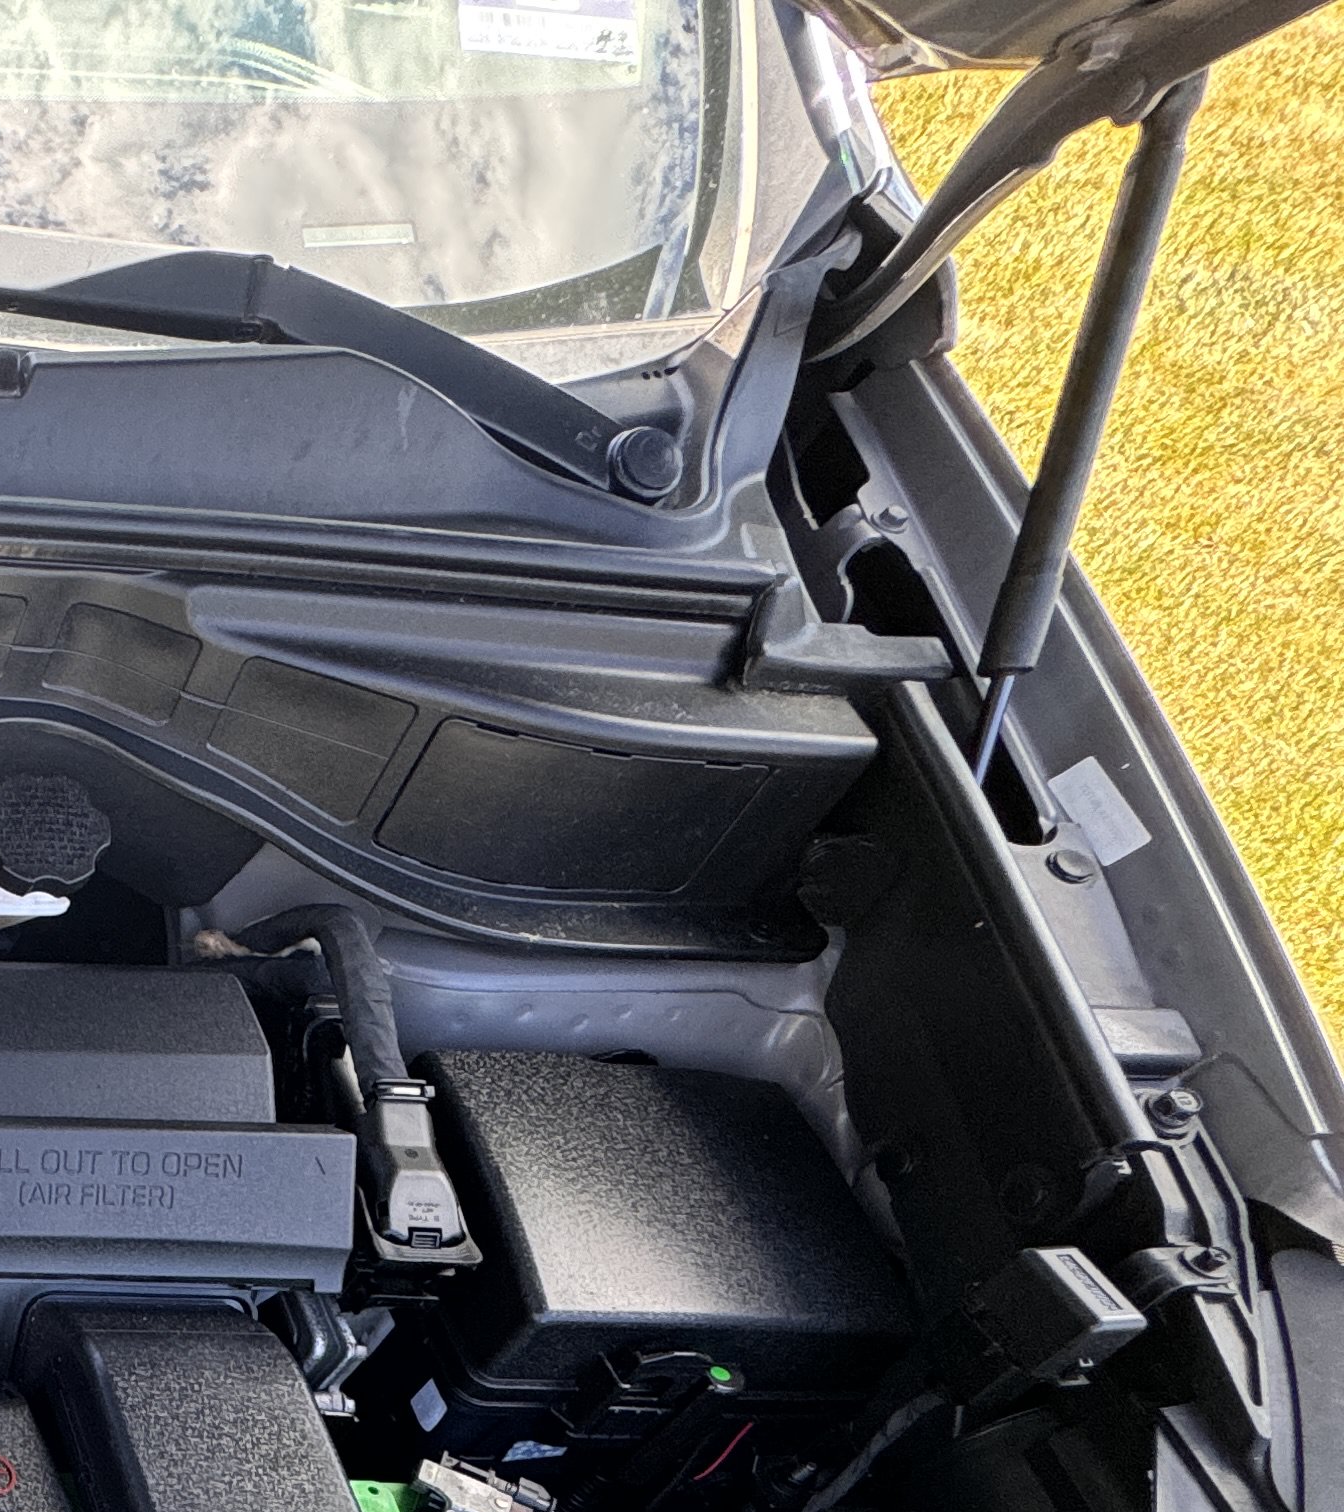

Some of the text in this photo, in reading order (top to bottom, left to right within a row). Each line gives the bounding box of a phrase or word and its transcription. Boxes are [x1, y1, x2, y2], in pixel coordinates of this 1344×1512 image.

[40, 1149, 103, 1176] OUT
[112, 1150, 151, 1177] TO
[161, 1151, 243, 1179] OPEN
[19, 1181, 175, 1210] (AIR FILTER)
